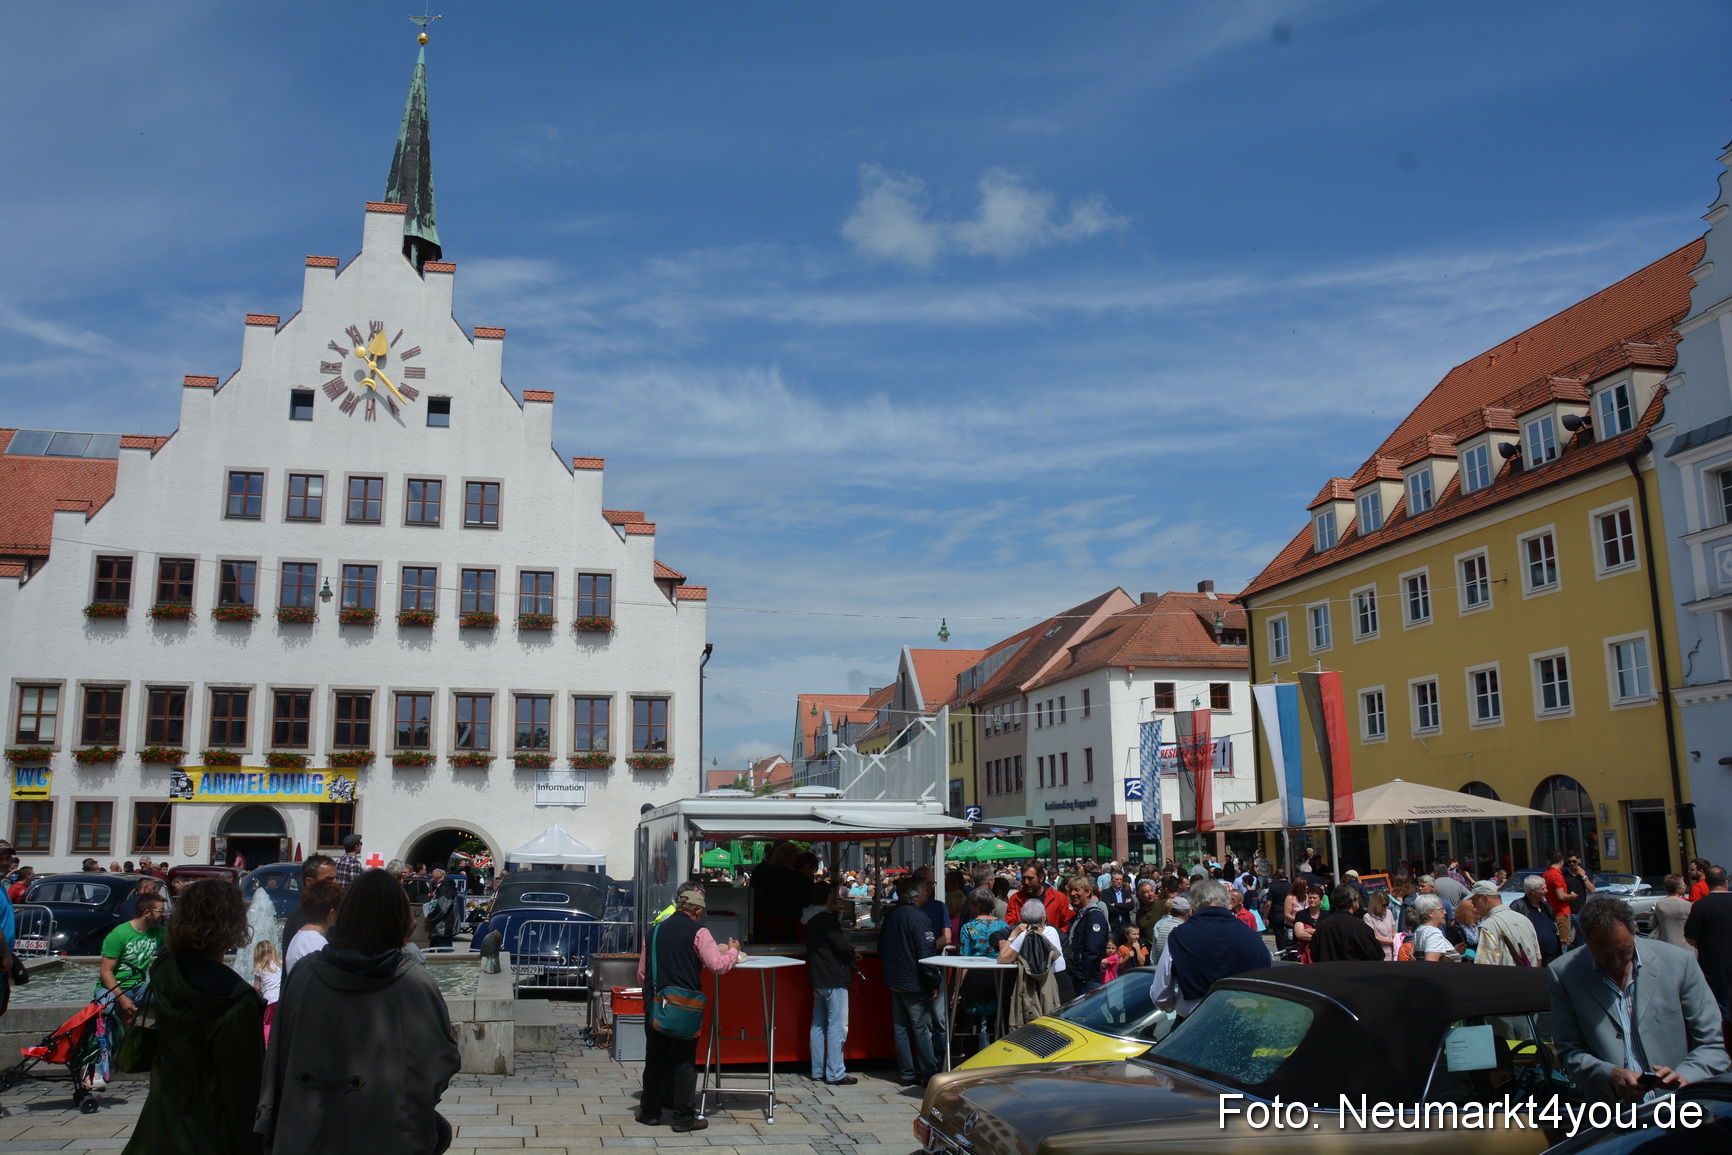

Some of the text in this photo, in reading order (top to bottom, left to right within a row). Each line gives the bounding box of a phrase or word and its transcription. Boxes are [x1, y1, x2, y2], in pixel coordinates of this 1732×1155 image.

[400, 345, 422, 361] II
[404, 366, 427, 378] III
[16, 767, 50, 787] WC
[197, 771, 325, 795] ANMELDUNG
[537, 783, 585, 792] Information
[126, 937, 158, 954] SUPER
